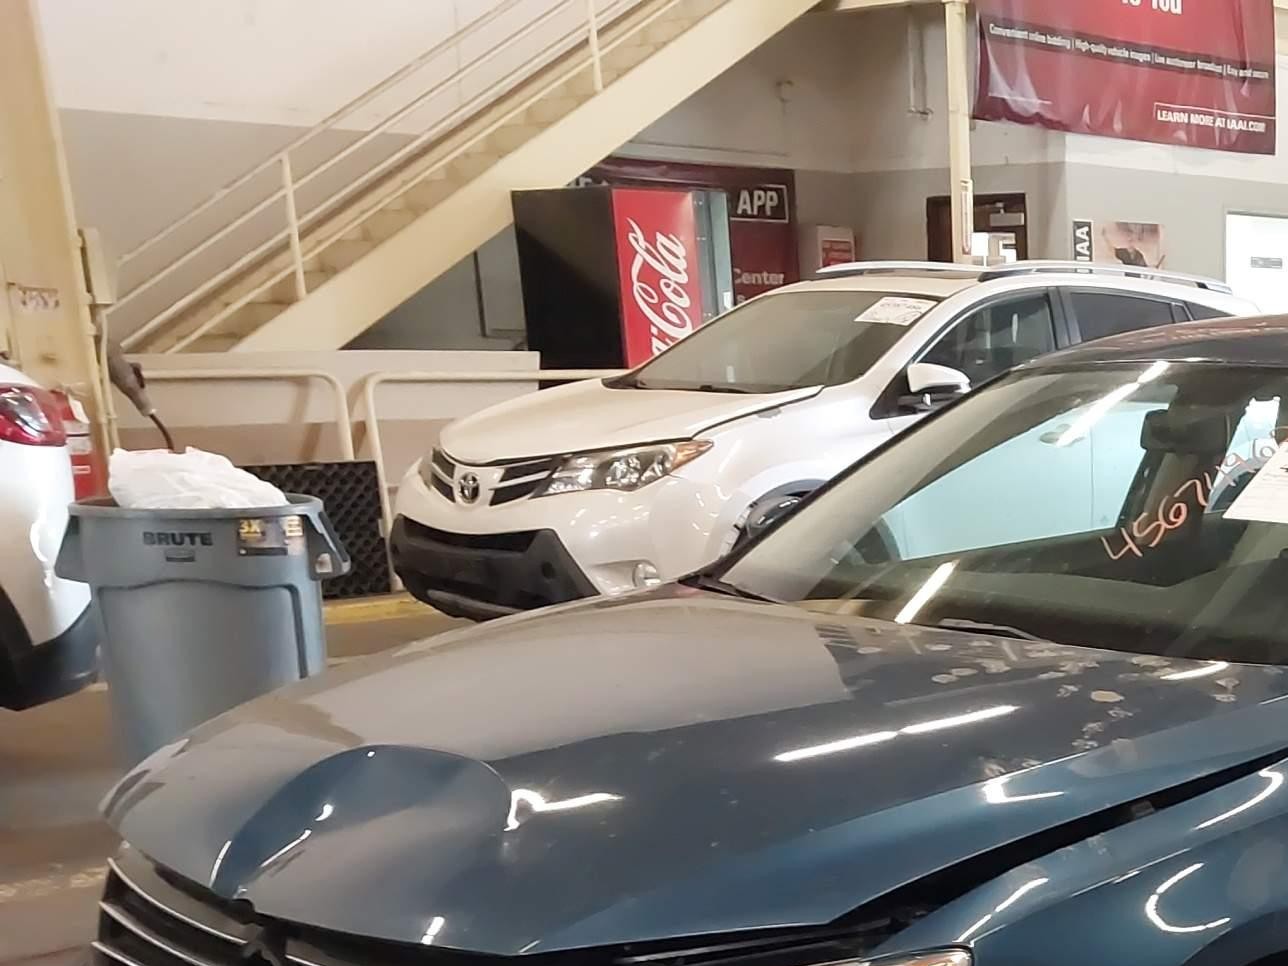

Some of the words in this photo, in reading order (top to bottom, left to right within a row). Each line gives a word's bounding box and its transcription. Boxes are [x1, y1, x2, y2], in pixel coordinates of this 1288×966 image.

[1157, 109, 1188, 124] LEARN
[1190, 113, 1214, 127] MORE
[1215, 117, 1226, 129] AT
[737, 190, 779, 216] APP
[143, 531, 213, 546] BRUTE
